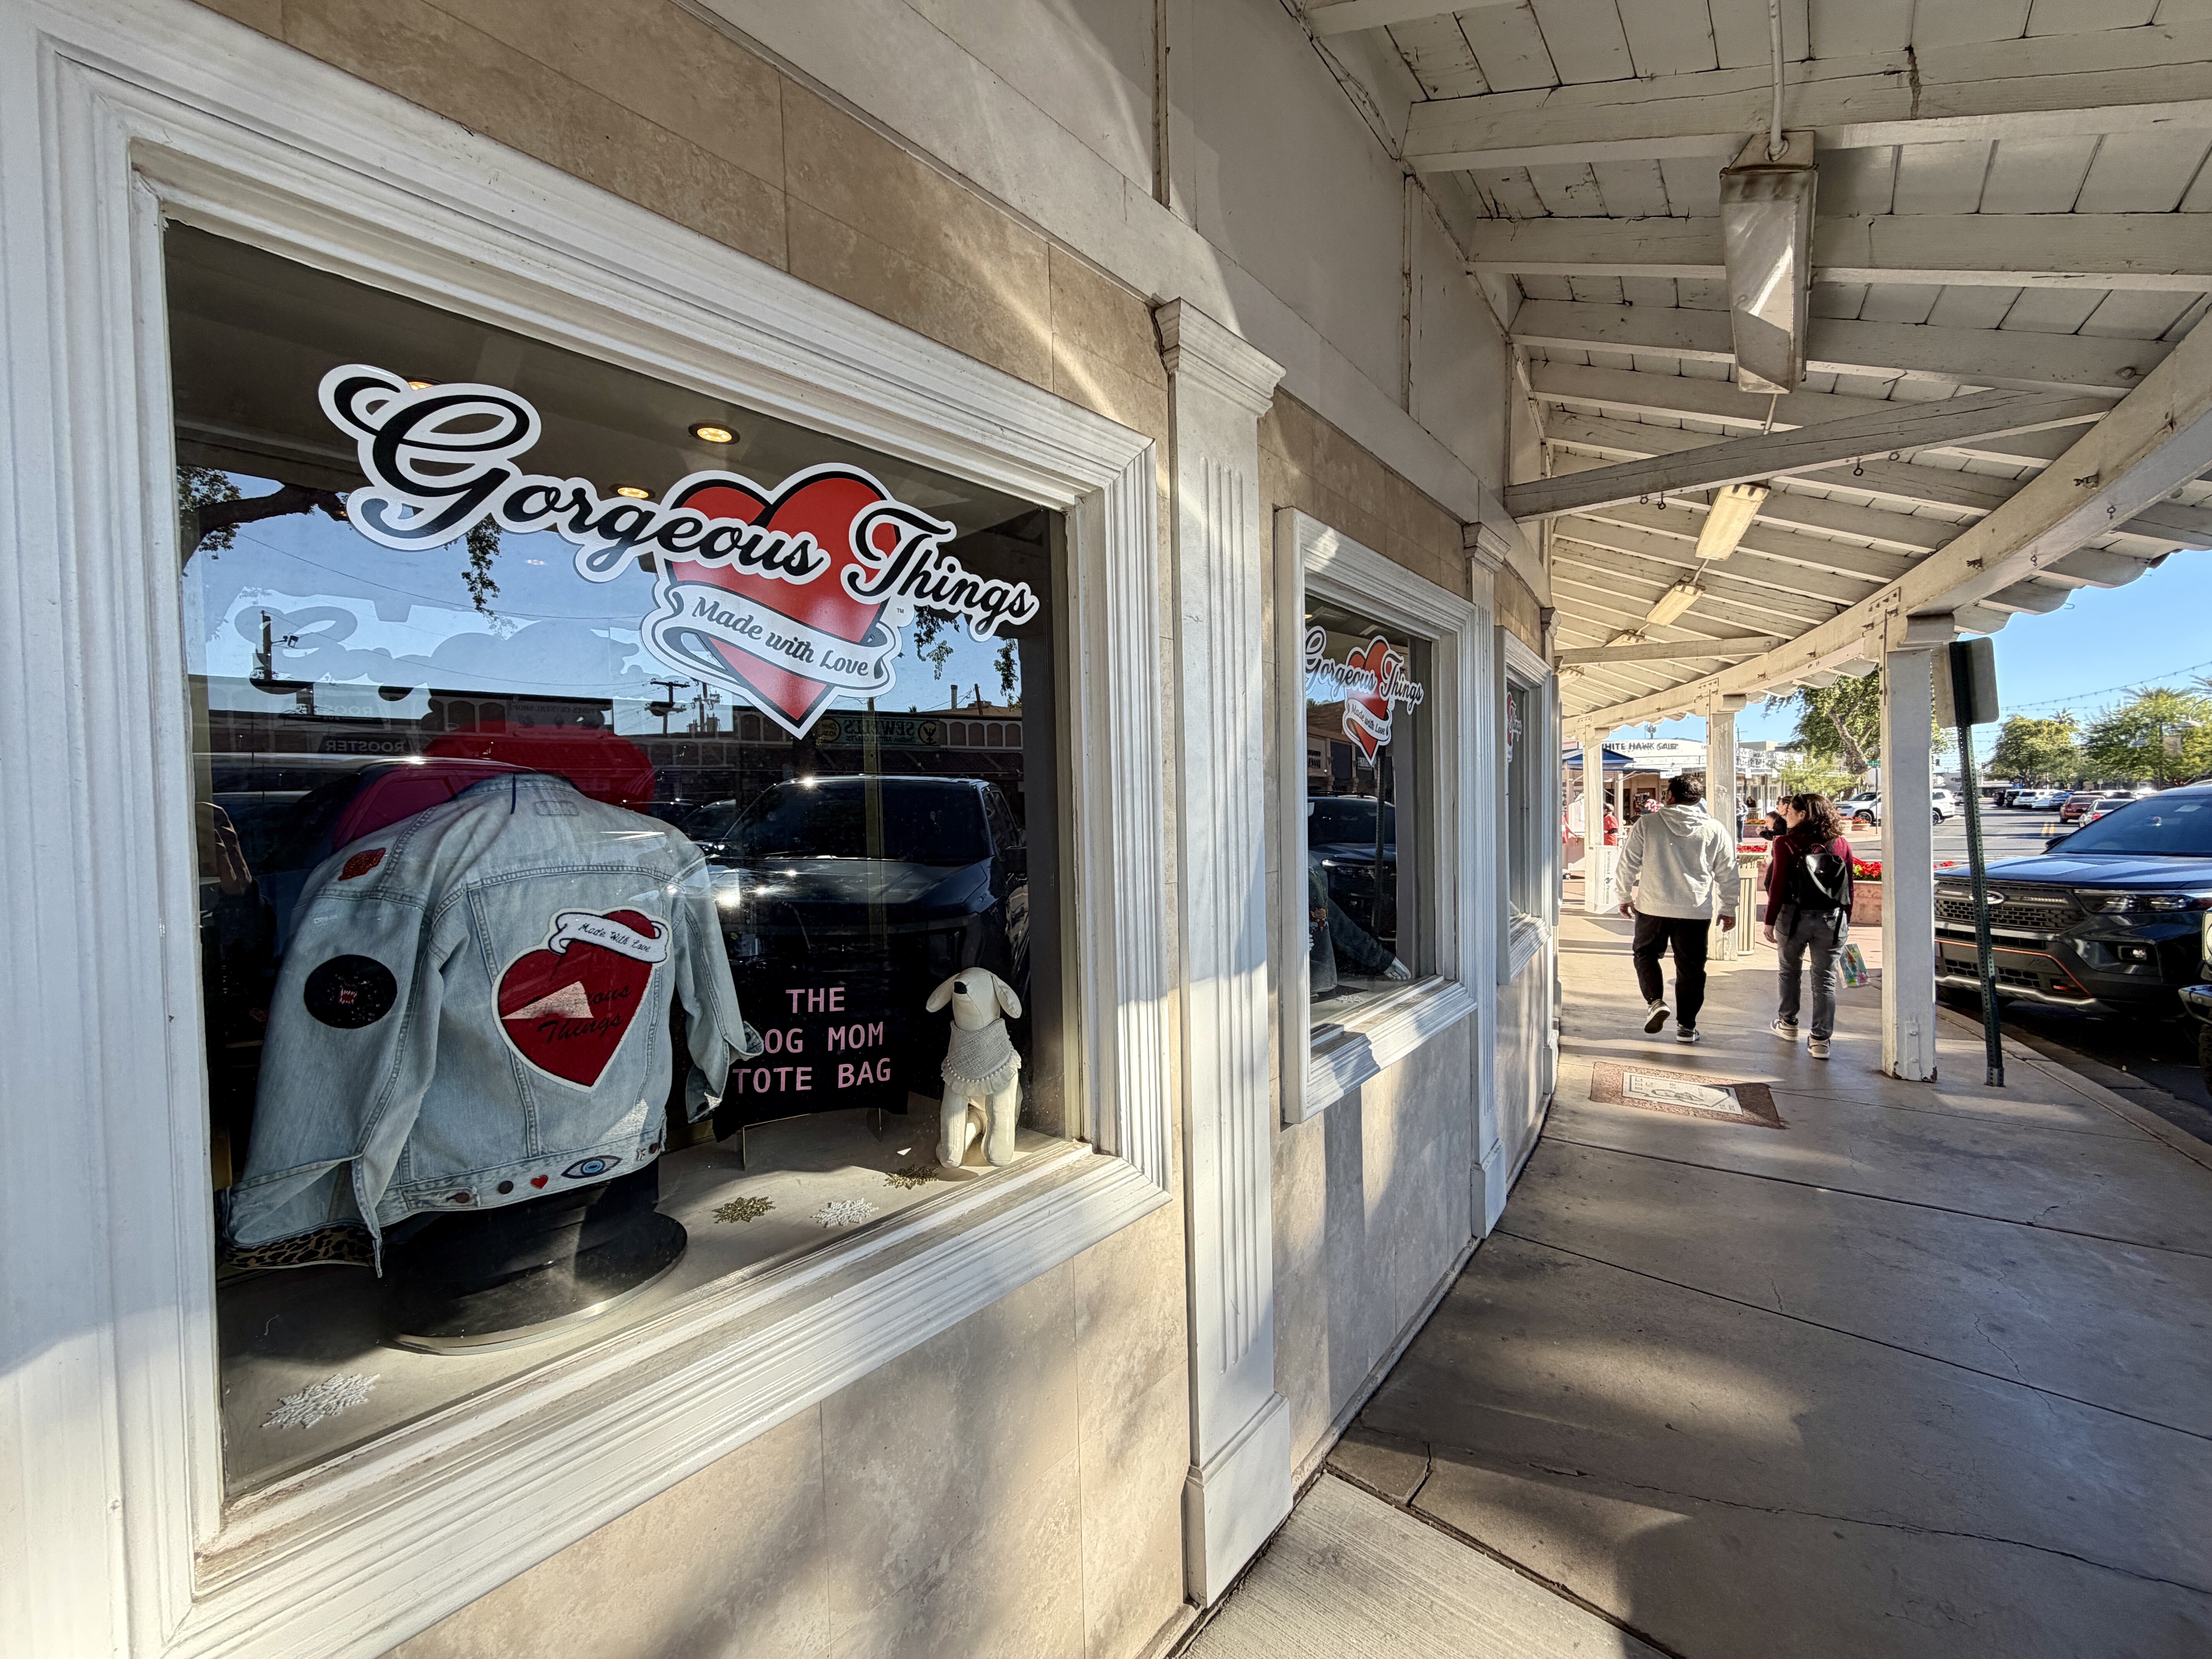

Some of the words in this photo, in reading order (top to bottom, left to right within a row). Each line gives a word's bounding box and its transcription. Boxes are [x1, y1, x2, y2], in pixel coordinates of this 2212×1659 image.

[332, 375, 825, 577] Gorgeous
[847, 507, 1037, 634] Things
[692, 596, 762, 640] Made
[765, 631, 814, 663] with
[819, 649, 869, 676] Love
[1305, 630, 1377, 697] Gorgeous
[1381, 653, 1423, 711] Things
[1351, 703, 1364, 721] Made
[1364, 718, 1374, 731] with
[1375, 723, 1385, 735] Love
[578, 923, 606, 937] Made
[610, 931, 630, 945] With
[631, 939, 651, 953] Love
[785, 987, 845, 1013] THE
[536, 1013, 623, 1043] Things
[764, 1028, 804, 1054] OG
[828, 1021, 884, 1051] MOM
[732, 1066, 812, 1094] TOTE
[838, 1057, 891, 1089] BAG
